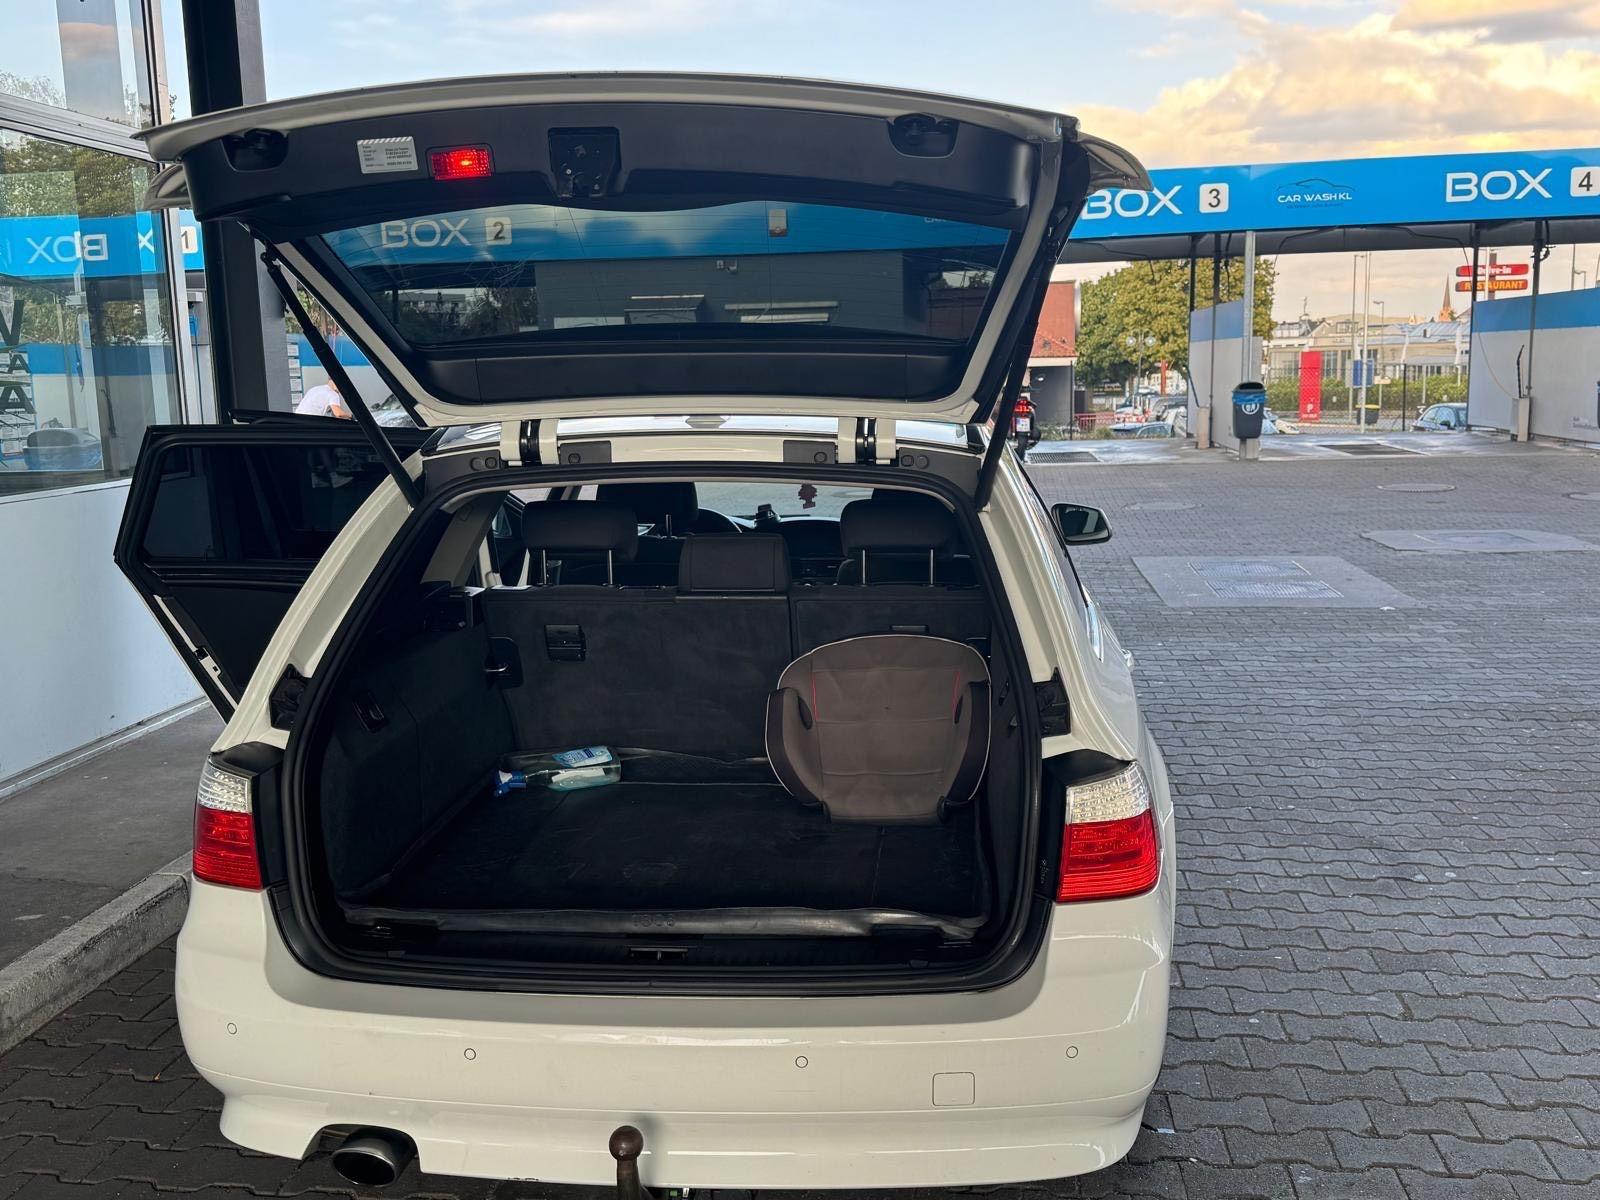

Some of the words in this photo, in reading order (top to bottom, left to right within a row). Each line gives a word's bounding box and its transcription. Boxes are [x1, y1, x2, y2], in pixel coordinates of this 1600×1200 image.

[1277, 194, 1301, 203] CAR
[1303, 193, 1337, 202] WASH
[1338, 192, 1352, 200] KL
[1446, 168, 1553, 203] BOX
[1578, 171, 1593, 192] 4
[1080, 184, 1183, 220] BOX
[1208, 188, 1221, 208] 3
[181, 230, 189, 249] 1
[380, 218, 472, 248] BOX
[492, 221, 506, 241] 2
[1465, 281, 1523, 290] RSTAURANT
